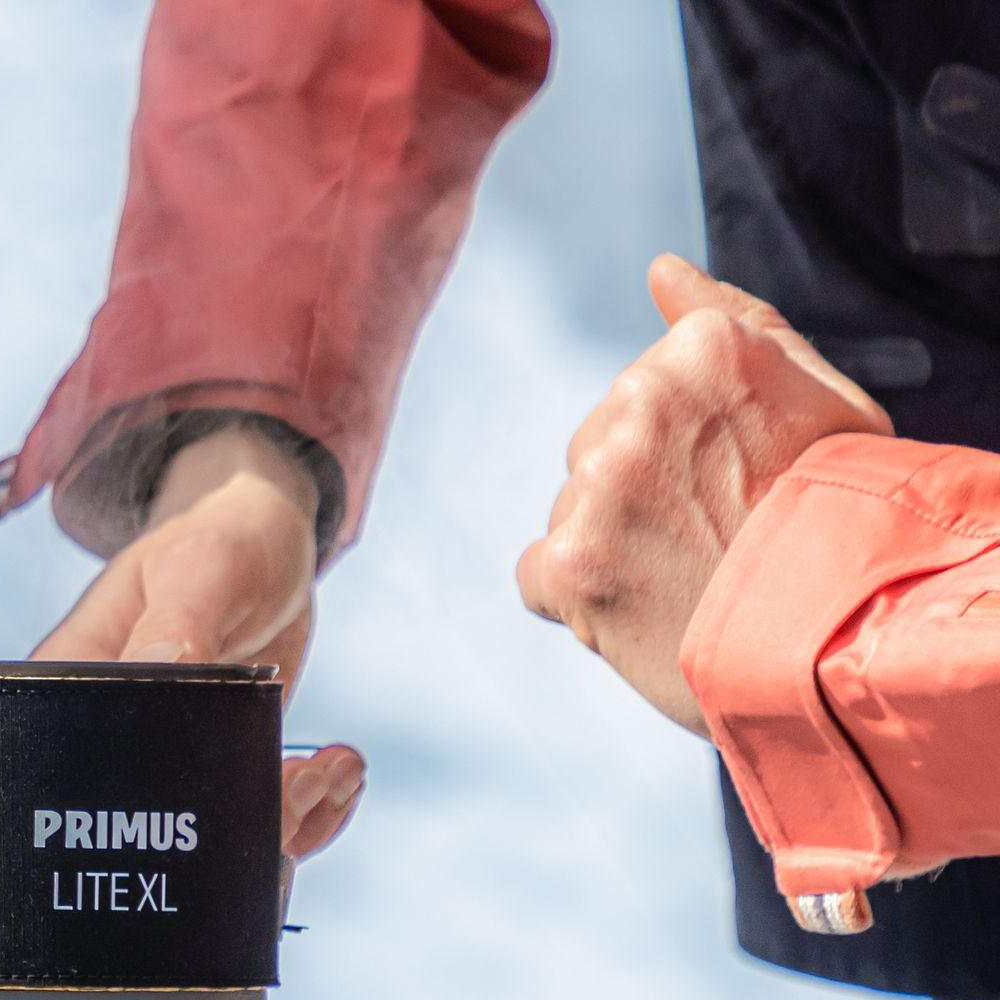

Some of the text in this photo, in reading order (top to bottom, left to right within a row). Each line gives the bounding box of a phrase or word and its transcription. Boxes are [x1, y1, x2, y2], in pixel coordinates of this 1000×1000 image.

[33, 809, 198, 851] PRIMUS
[53, 871, 178, 912] LITE XL
